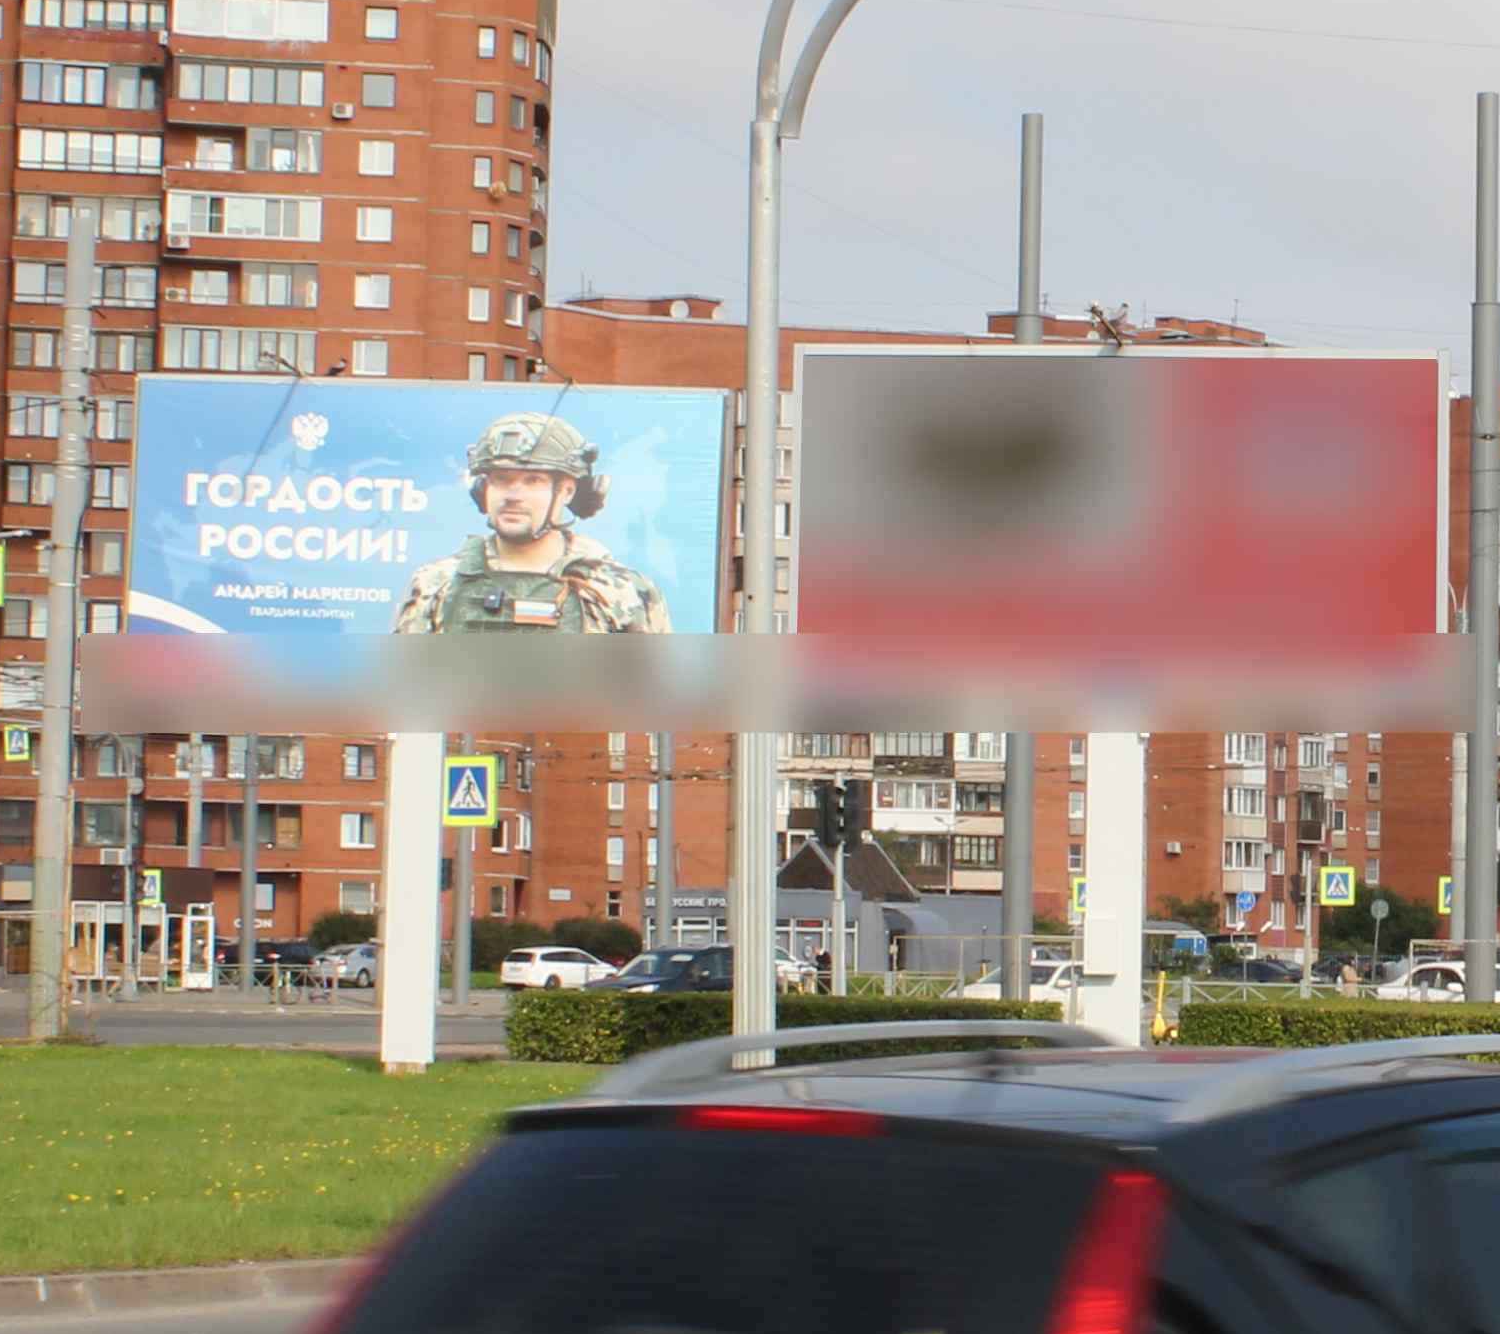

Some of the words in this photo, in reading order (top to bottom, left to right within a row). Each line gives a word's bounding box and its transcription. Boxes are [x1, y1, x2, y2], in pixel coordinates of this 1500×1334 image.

[184, 472, 429, 514] ГОРДОСТЬ
[199, 523, 409, 564] РОССИИ!
[213, 581, 288, 601] АНДРЕЙ
